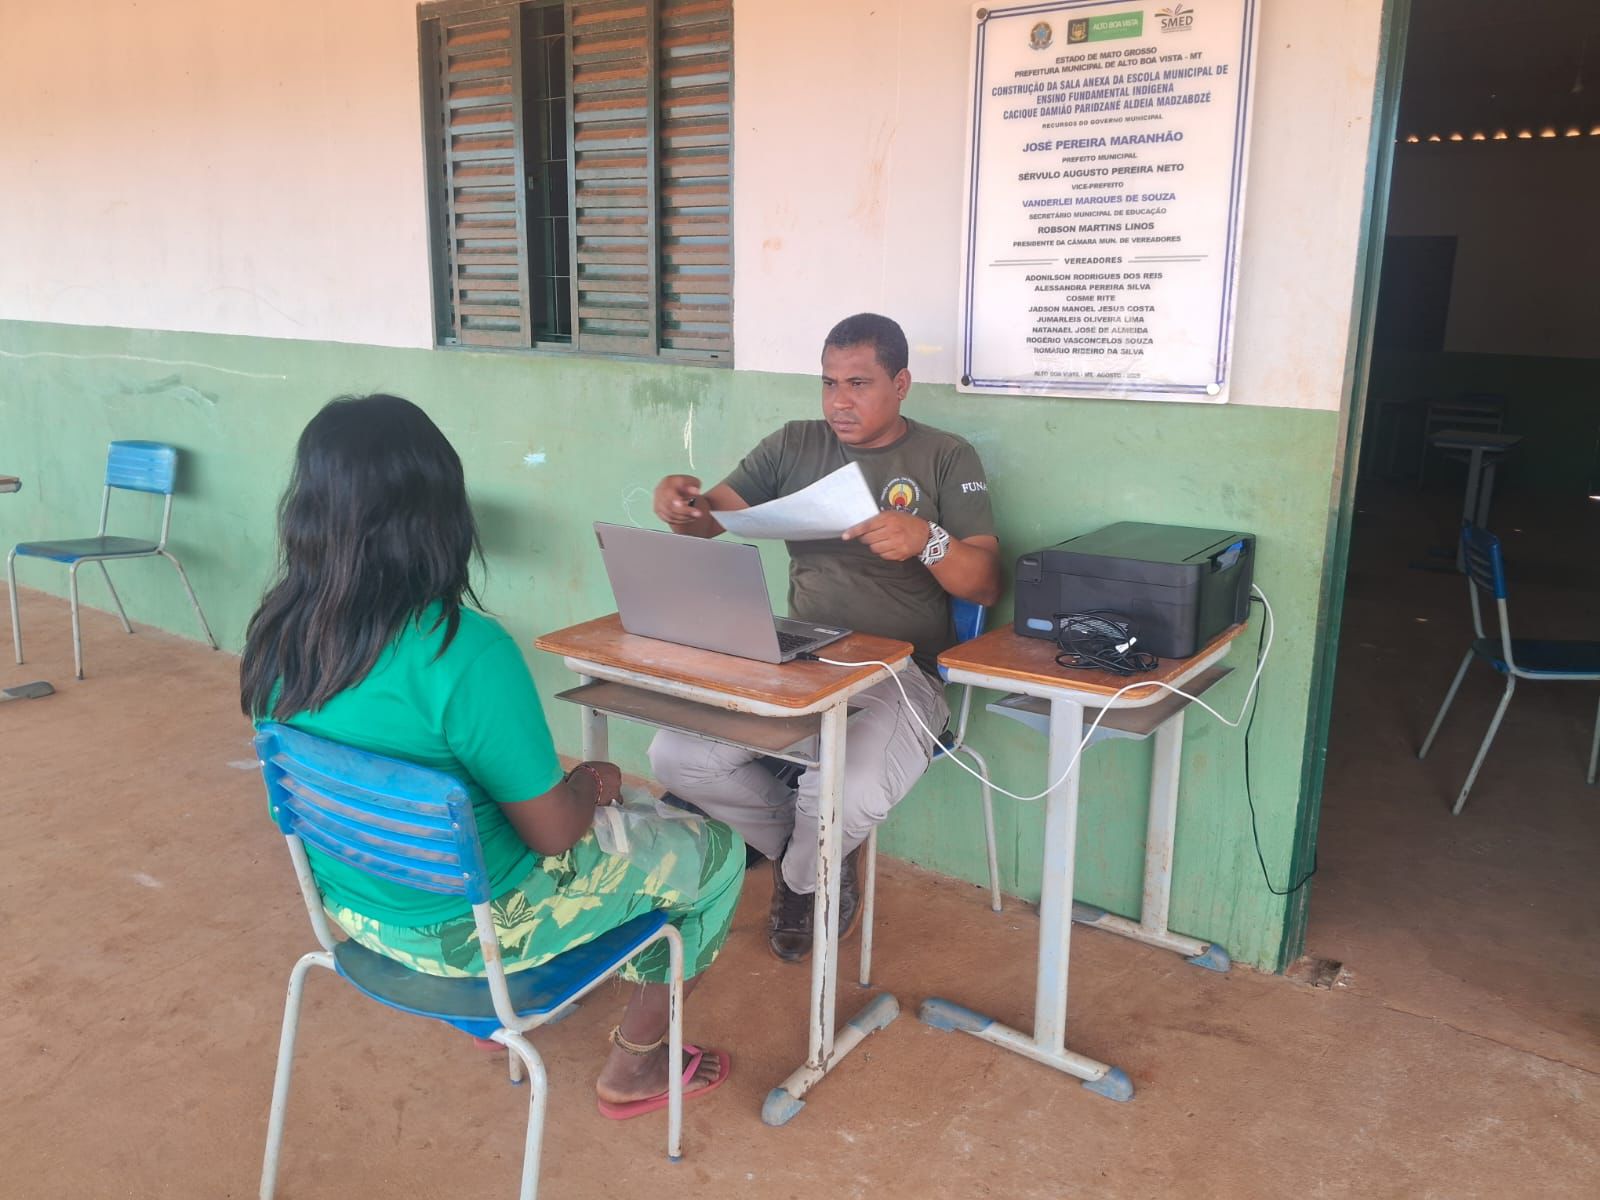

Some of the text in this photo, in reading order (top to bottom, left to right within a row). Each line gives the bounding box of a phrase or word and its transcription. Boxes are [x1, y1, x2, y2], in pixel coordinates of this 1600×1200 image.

[1093, 19, 1139, 30] ALTO BOA VISTA
[1161, 15, 1194, 29] SMED
[1055, 53, 1085, 64] ESTADO
[1099, 51, 1121, 59] MATO
[1123, 46, 1157, 57] GROSSO
[1014, 68, 1060, 78] PREFEITURA
[1061, 62, 1103, 73] MUNICIPAL
[1104, 60, 1116, 69] DE
[1117, 58, 1138, 67] ALTO
[1139, 56, 1157, 65] BOA
[1159, 54, 1183, 63] VISTA
[1189, 52, 1203, 60] MT
[991, 64, 1229, 97] CONSTRUÇÃO DA SALA ANEXA DA ESCOLA MUNICIPAL DE
[1036, 93, 1066, 105] ENSINO
[1068, 87, 1130, 102] FUNDAMENTAL
[1003, 107, 1038, 120] CACIQUE
[1123, 98, 1154, 109] ALDEIA
[1042, 121, 1077, 129] RECURSOS
[1090, 117, 1124, 125] GOVERNO
[1125, 114, 1164, 123] MUNICIPAL
[1055, 137, 1107, 150] PEREIRA
[1110, 130, 1184, 146] MARANHÃO
[1062, 152, 1138, 163] PREFEITO MUNICIPAL
[1063, 168, 1109, 178] AUGUSTO
[1111, 165, 1154, 175] PEREIRA
[1156, 163, 1185, 173] NETO
[1071, 181, 1124, 190] VICE-PREFEITO
[1022, 192, 1176, 208] VANDERLEI MARQUES DE SOUZA
[1073, 209, 1112, 218] MUNICIPAL
[1037, 222, 1155, 234] ROBSON MARTINS LINOS
[1013, 239, 1054, 248] PRESIDENTE
[1055, 238, 1066, 246] DA
[1098, 237, 1118, 245] MUN.
[1119, 236, 1130, 244] DE
[1131, 234, 1182, 244] VEREADORES
[1064, 256, 1123, 265] VEREADORES
[1025, 272, 1163, 282] ADONILSON RODRIGUES DOS REIS
[1034, 284, 1087, 292] ALESSANDRA
[1127, 283, 1151, 291] SILVA
[1066, 294, 1095, 302] COSME
[1028, 305, 1155, 313] JADSON MANOEL JESUS COSTA
[1036, 316, 1145, 324] JUMARLEIS OLIVEIRA LIMA
[1098, 326, 1109, 334] DE
[1110, 326, 1149, 334] ALMEIDA
[1063, 337, 1123, 345] VASCONCELOS
[1124, 337, 1154, 345] SOUZA
[1071, 347, 1105, 355] RIBEIRO
[1120, 348, 1145, 356] SILVA
